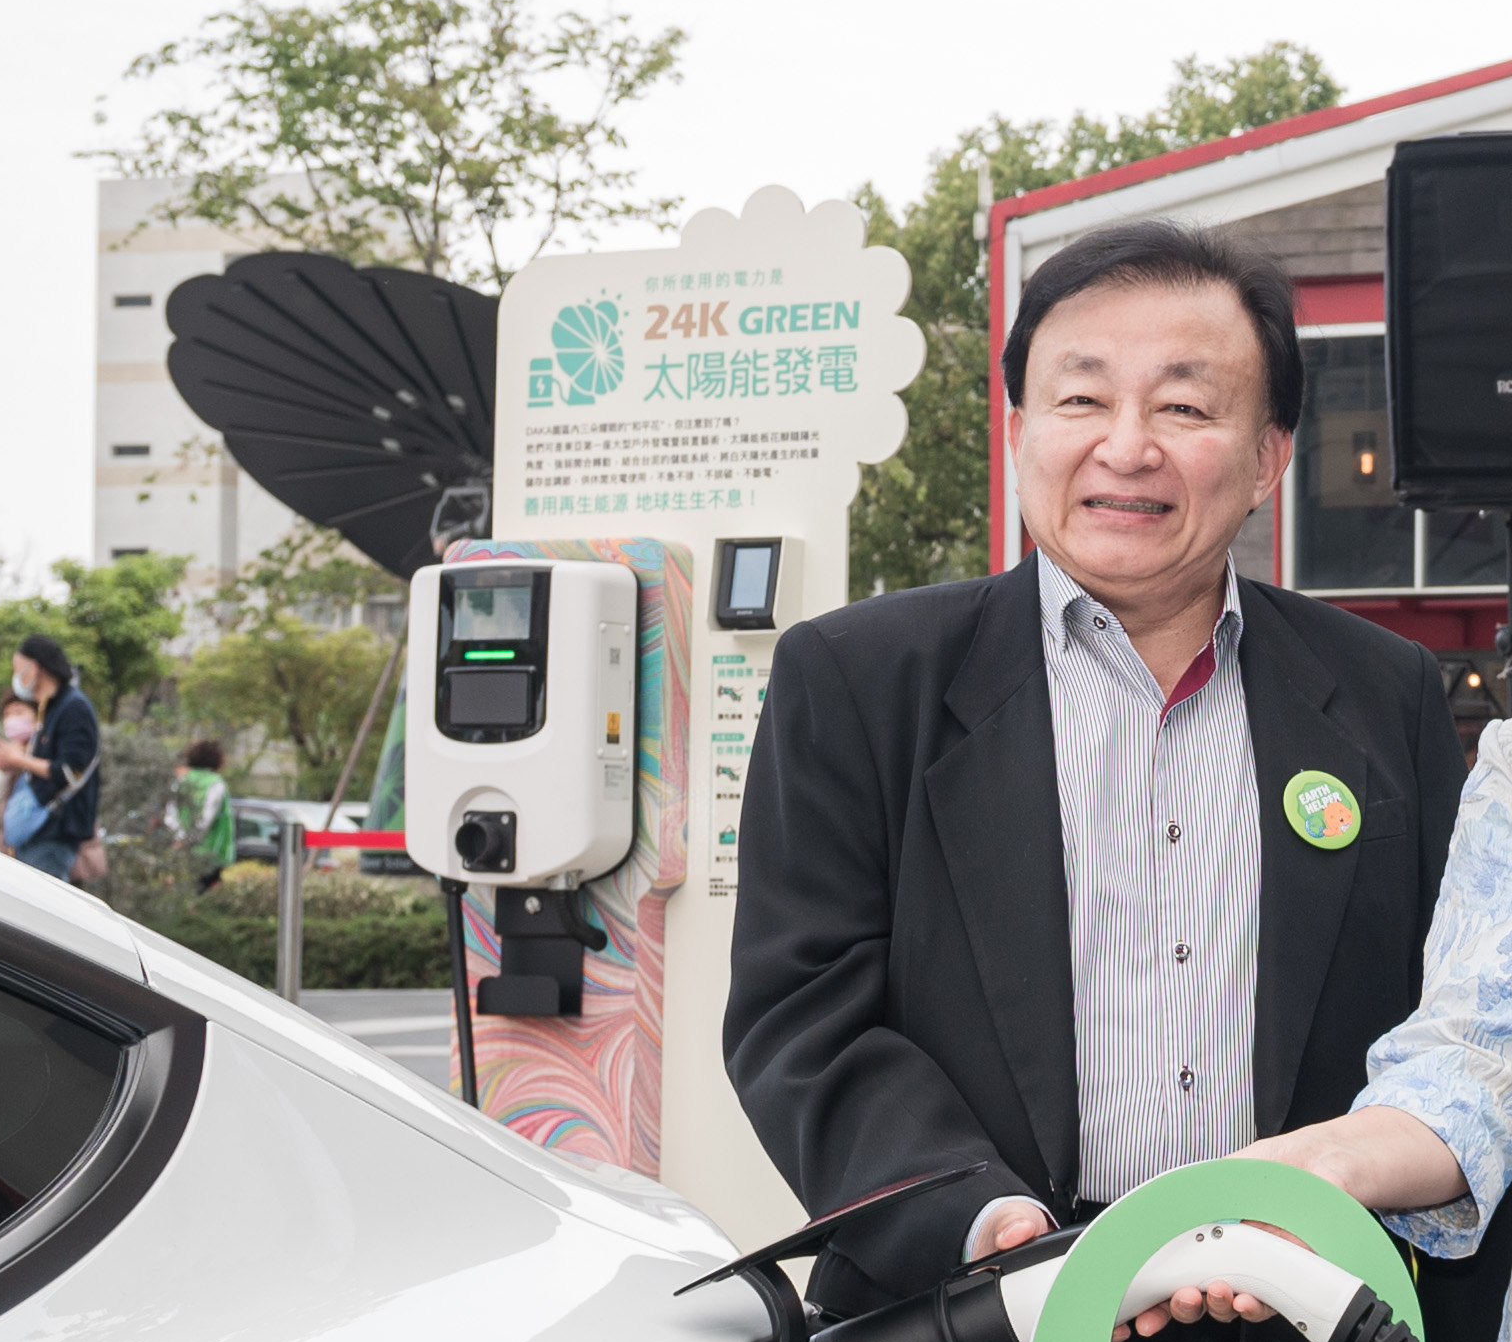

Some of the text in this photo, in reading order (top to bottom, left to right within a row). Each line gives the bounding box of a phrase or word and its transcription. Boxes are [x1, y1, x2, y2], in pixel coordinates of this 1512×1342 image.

[644, 268, 784, 293] 你所使用的電力是
[644, 300, 860, 341] 24K GREEN
[643, 345, 858, 402] 太陽能發電
[525, 493, 629, 517] 善用再生能源
[1298, 784, 1330, 805] EARTH
[1304, 791, 1342, 815] HELPER
